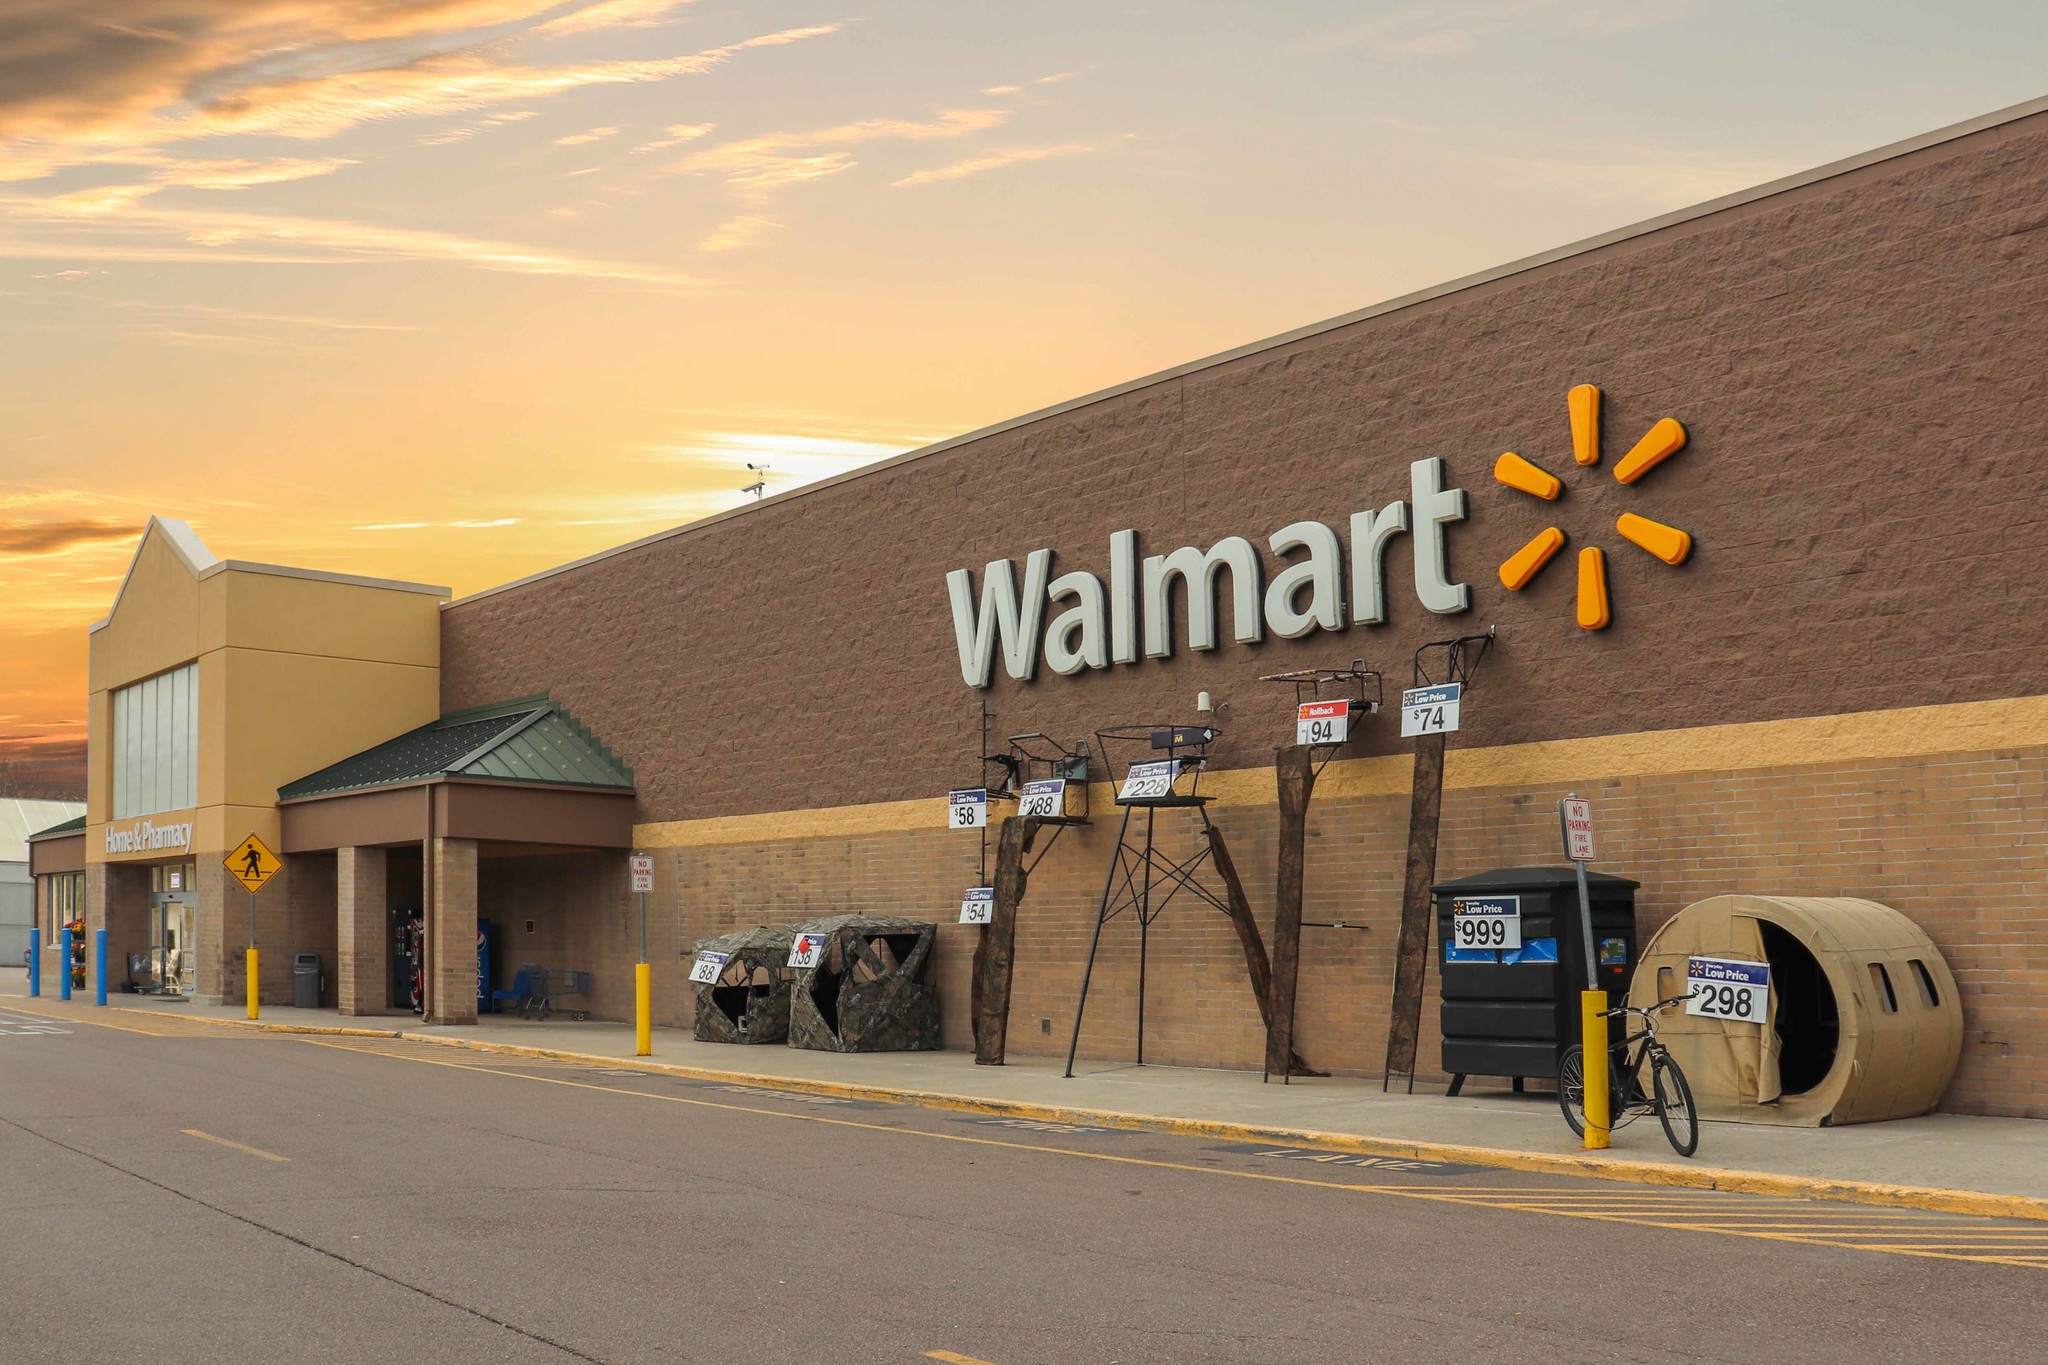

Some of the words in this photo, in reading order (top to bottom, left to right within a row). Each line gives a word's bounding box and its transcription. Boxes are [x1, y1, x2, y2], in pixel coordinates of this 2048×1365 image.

[946, 456, 1469, 689] Walmart
[1415, 694, 1429, 704] Low
[1429, 693, 1447, 702] Price
[1309, 706, 1334, 716] Rollback
[1413, 706, 1445, 731] $74
[1311, 720, 1333, 742] 94
[1140, 769, 1152, 777] Low
[1152, 767, 1168, 775] Price
[1040, 785, 1052, 793] Price
[967, 795, 978, 803] Price
[954, 806, 974, 825] $58
[1573, 805, 1583, 817] NO
[1568, 820, 1591, 832] PARKING
[105, 826, 133, 854] Home
[134, 822, 142, 852] &
[142, 820, 193, 854] Pharmacy
[1574, 834, 1587, 842] FIRE
[1575, 845, 1589, 853] LANE
[966, 903, 986, 921] $54
[1466, 905, 1483, 914] Low
[1483, 904, 1503, 914] Price
[1455, 919, 1506, 946] $999
[1705, 968, 1725, 979] Low
[1726, 970, 1750, 981] Price
[1692, 983, 1752, 1018] $298
